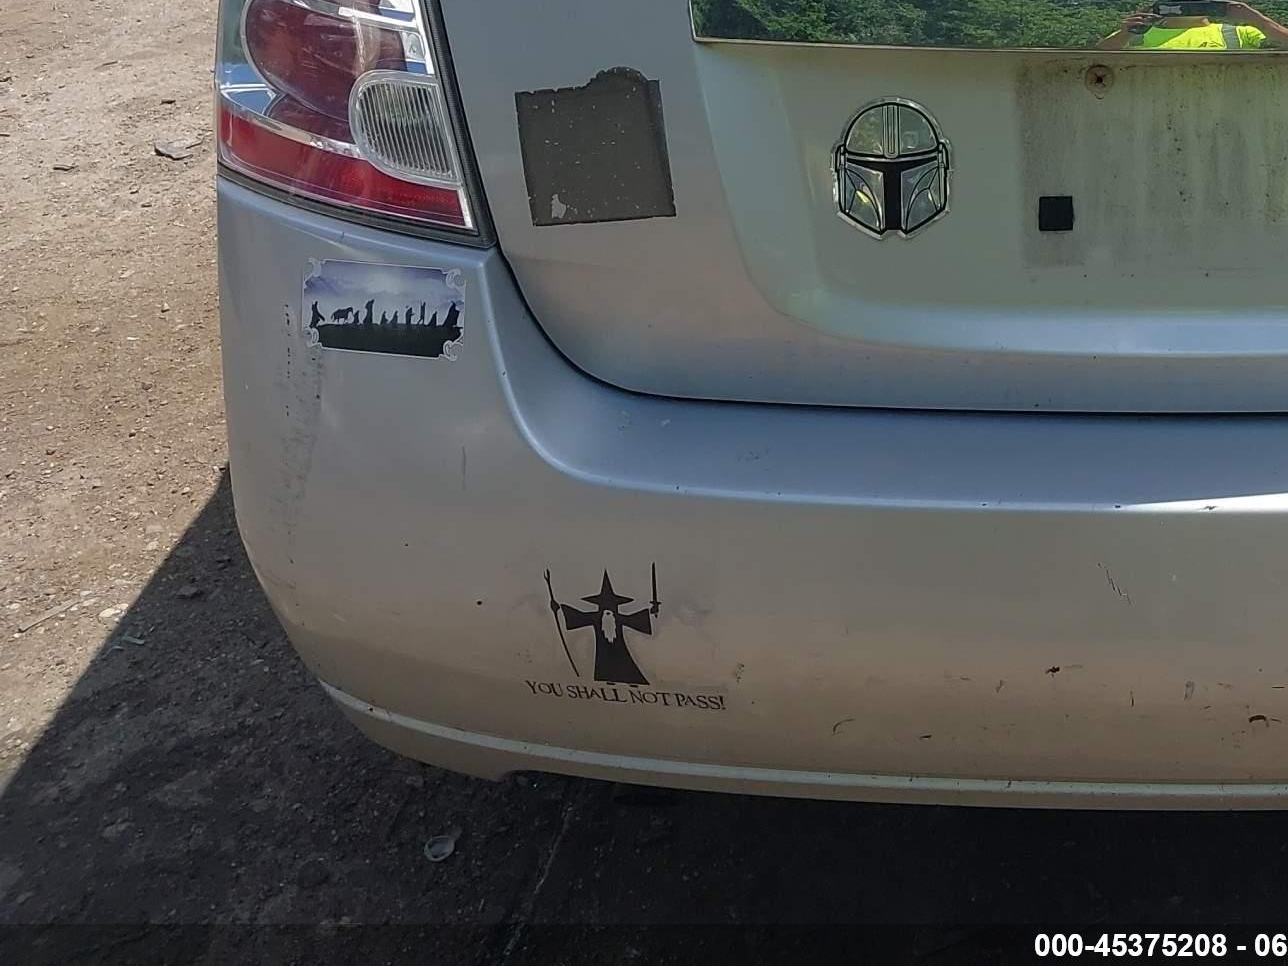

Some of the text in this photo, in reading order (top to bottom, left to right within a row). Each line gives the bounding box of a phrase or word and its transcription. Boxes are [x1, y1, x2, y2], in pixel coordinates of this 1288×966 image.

[525, 680, 727, 711] YOU SHALL NOT PASS!
